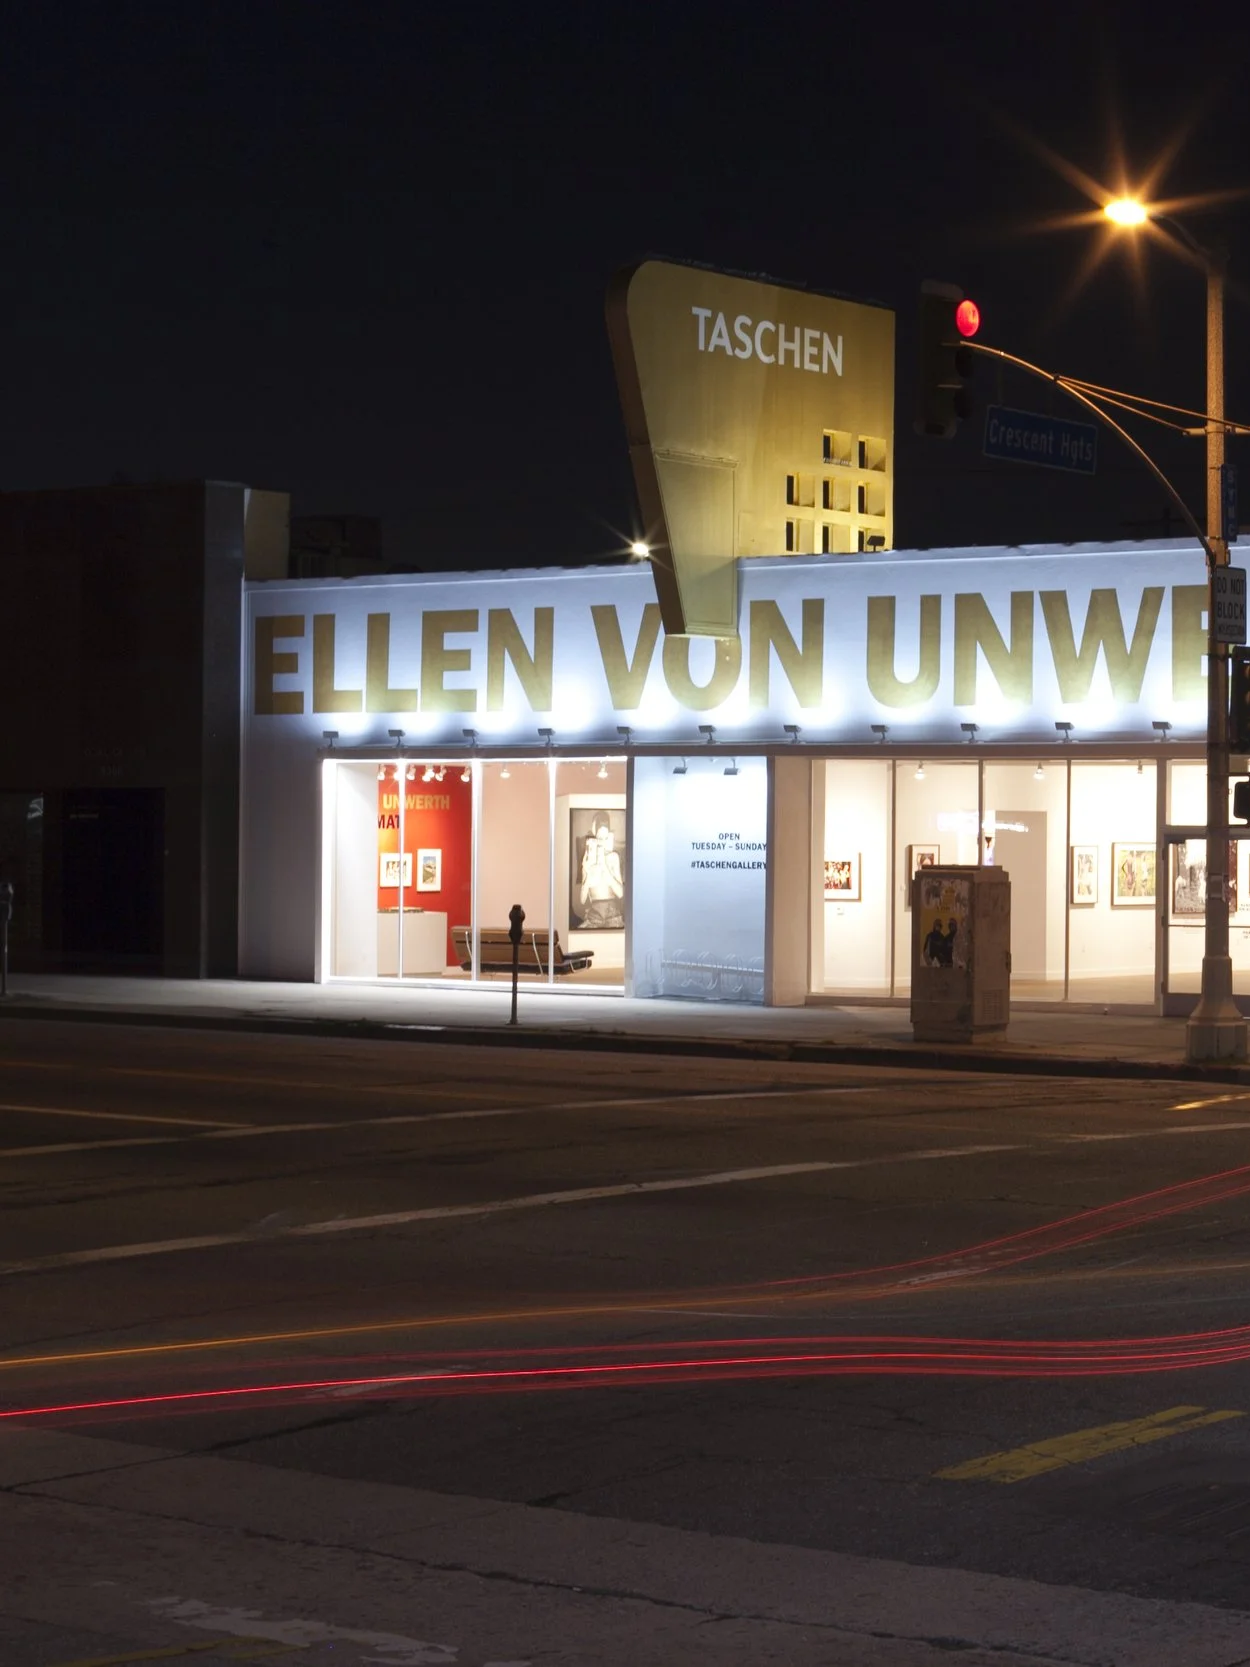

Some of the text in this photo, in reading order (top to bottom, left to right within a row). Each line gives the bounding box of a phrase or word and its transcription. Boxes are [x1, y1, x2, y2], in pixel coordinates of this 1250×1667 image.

[691, 306, 843, 376] TASCHEN
[989, 418, 1094, 466] Crescent Hgts
[1217, 577, 1244, 595] DO NOT
[1217, 601, 1245, 621] BLOCK
[254, 606, 554, 715] ELLEN
[591, 597, 825, 712] VON
[383, 794, 450, 810] UNWERTH
[691, 842, 726, 850] TUESDAY
[691, 861, 767, 870] #TASCHENGALLERY
